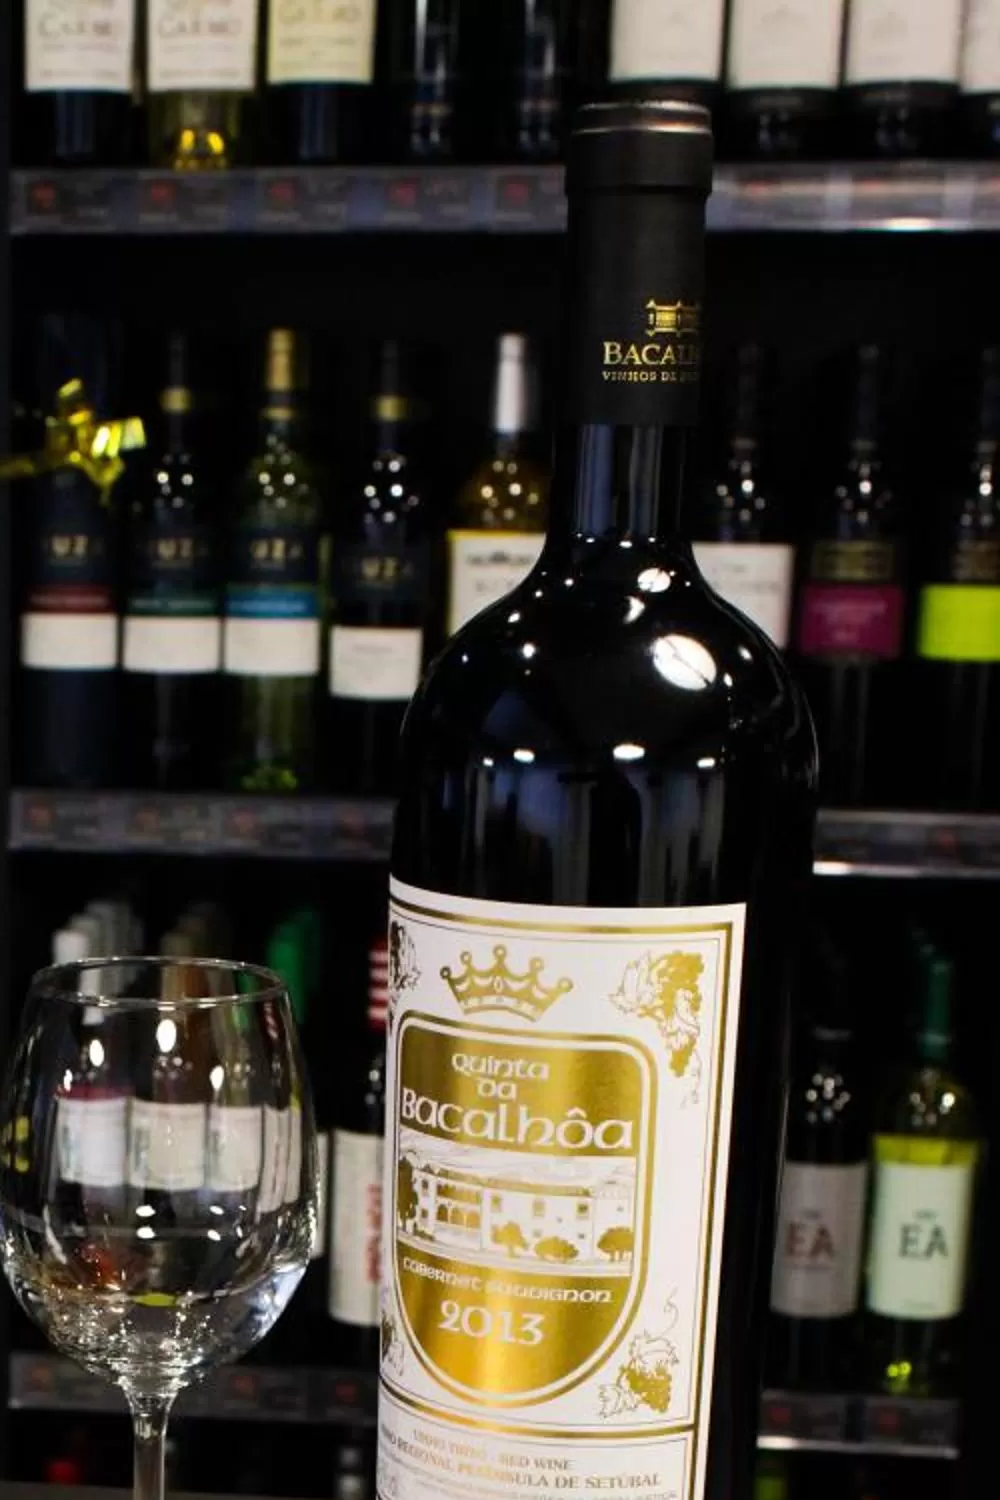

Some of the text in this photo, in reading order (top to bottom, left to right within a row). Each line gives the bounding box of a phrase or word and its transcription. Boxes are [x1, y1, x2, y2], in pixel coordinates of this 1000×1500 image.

[899, 1222, 950, 1259] EA
[438, 1300, 545, 1346] 2013
[533, 1457, 574, 1471] WINE
[554, 1474, 580, 1490] DE
